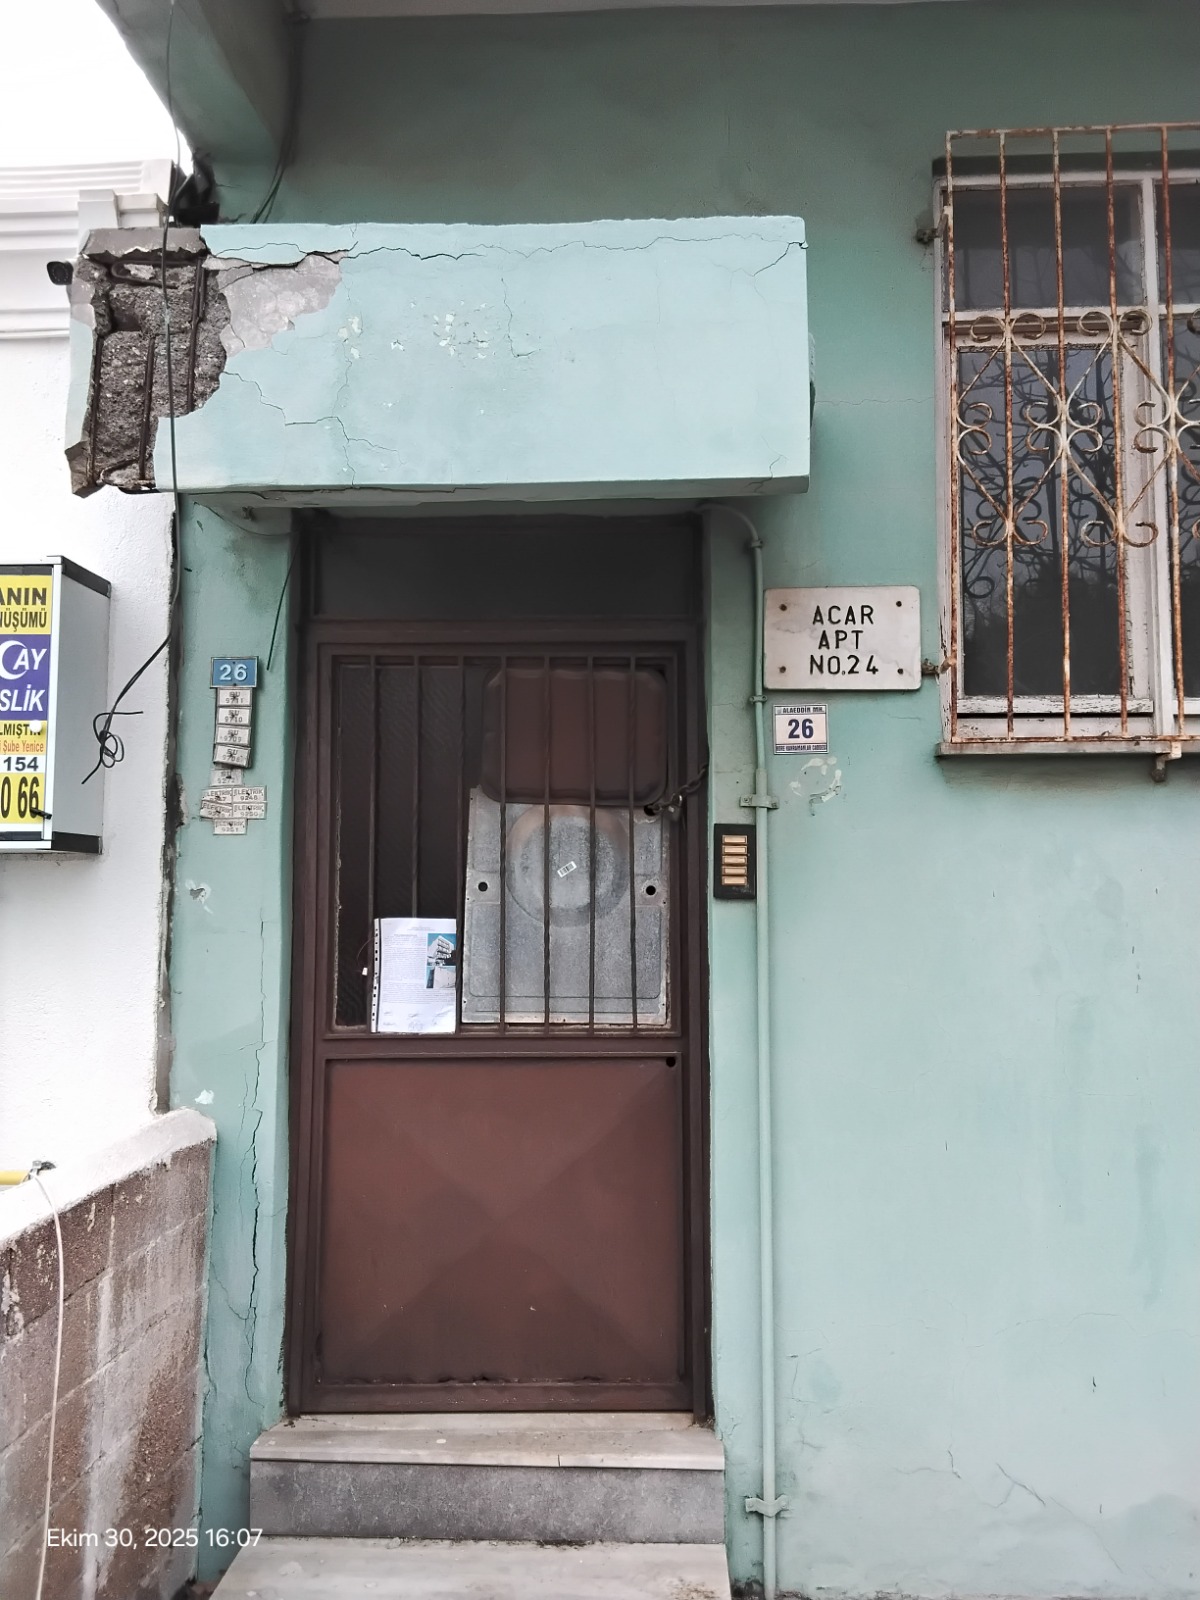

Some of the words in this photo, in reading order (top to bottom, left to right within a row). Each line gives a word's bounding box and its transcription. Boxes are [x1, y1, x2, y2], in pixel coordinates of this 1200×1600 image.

[812, 605, 874, 625] ACAR
[818, 630, 864, 650] APT
[220, 664, 247, 681] 26
[809, 654, 879, 675] NO.24
[0, 723, 41, 739] MIŞT
[788, 718, 814, 739] 26
[3, 740, 20, 755] Şube
[22, 740, 44, 753] Yenice
[3, 757, 39, 772] 154
[18, 776, 39, 818] 66
